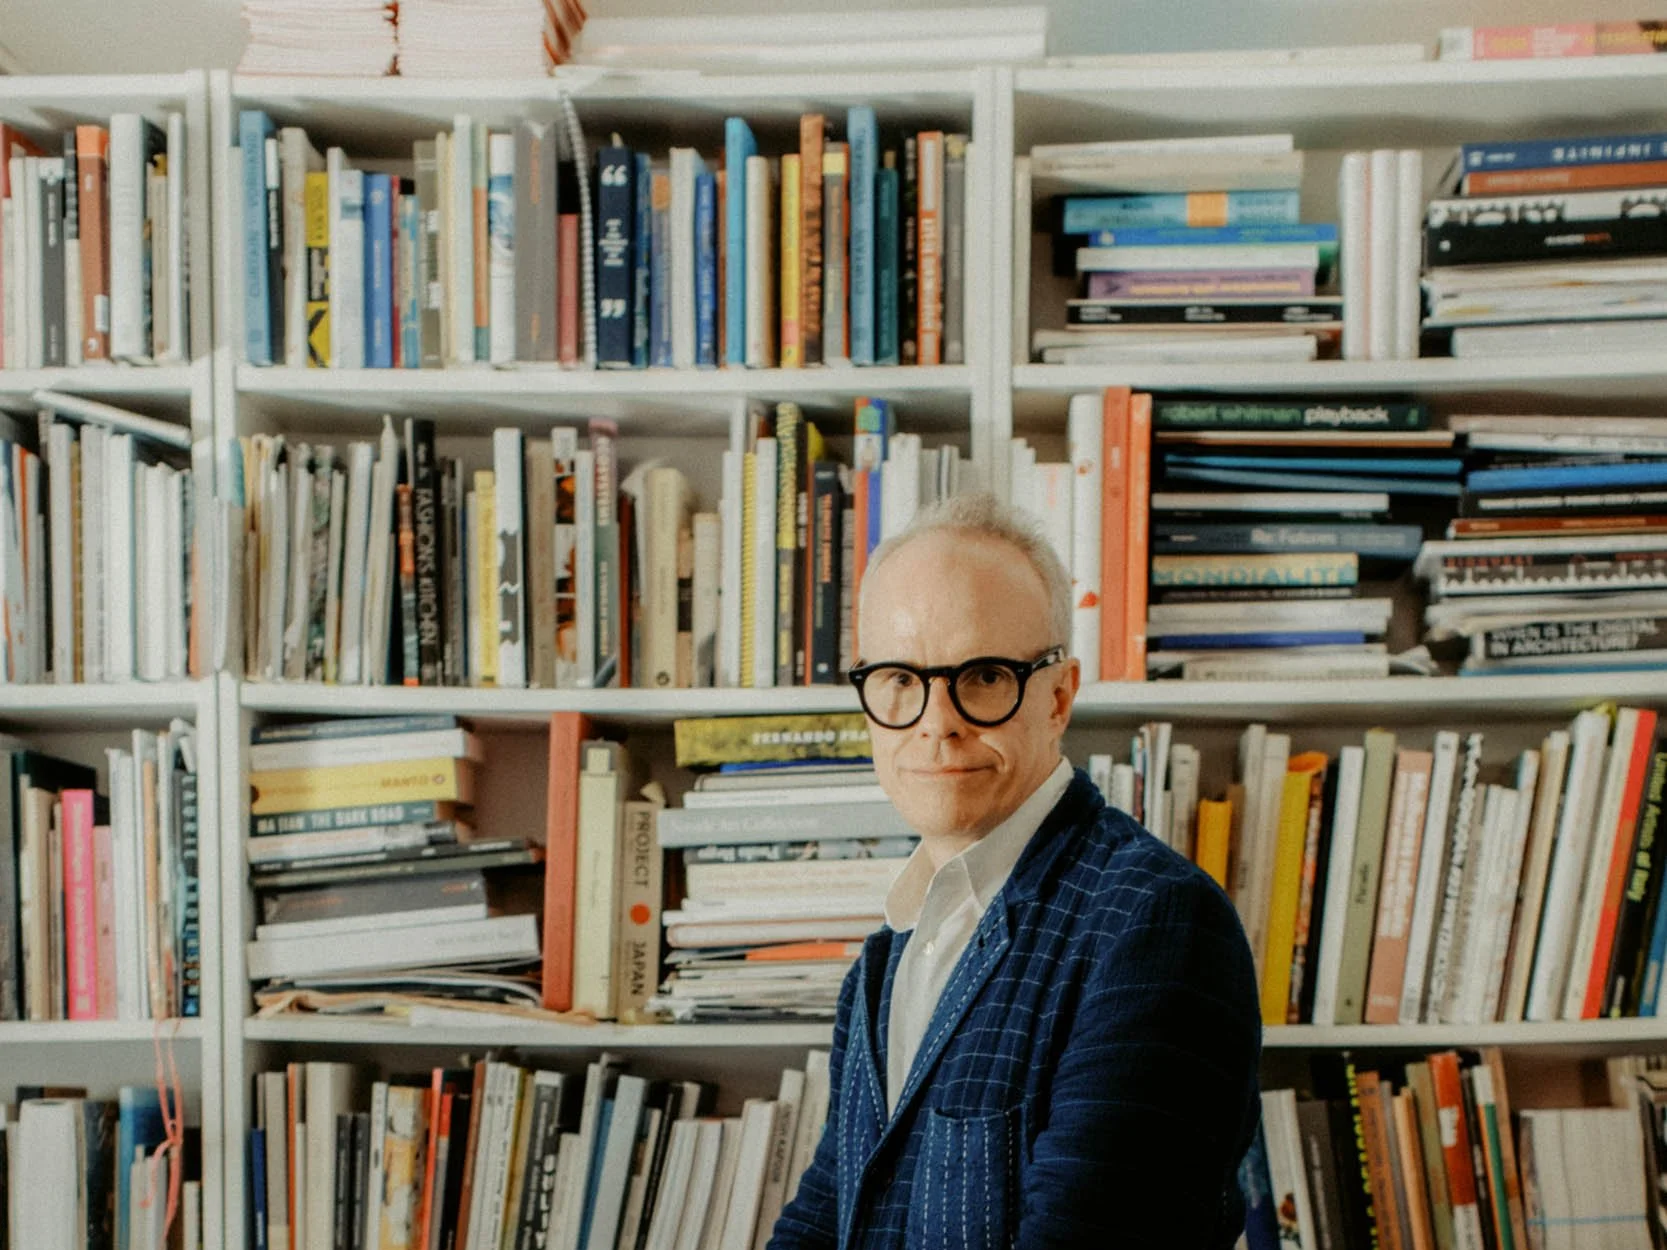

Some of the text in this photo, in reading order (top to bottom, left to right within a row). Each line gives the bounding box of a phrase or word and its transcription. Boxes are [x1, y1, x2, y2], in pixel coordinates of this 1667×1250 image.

[1303, 405, 1389, 426] playback
[1563, 622, 1592, 637] THE
[1490, 641, 1509, 656] IN
[752, 730, 836, 746] FERNANDO
[311, 812, 331, 828] THE
[335, 809, 367, 826] DARK
[370, 805, 405, 822] ROAD
[630, 810, 651, 997] PROJECT JAPAN
